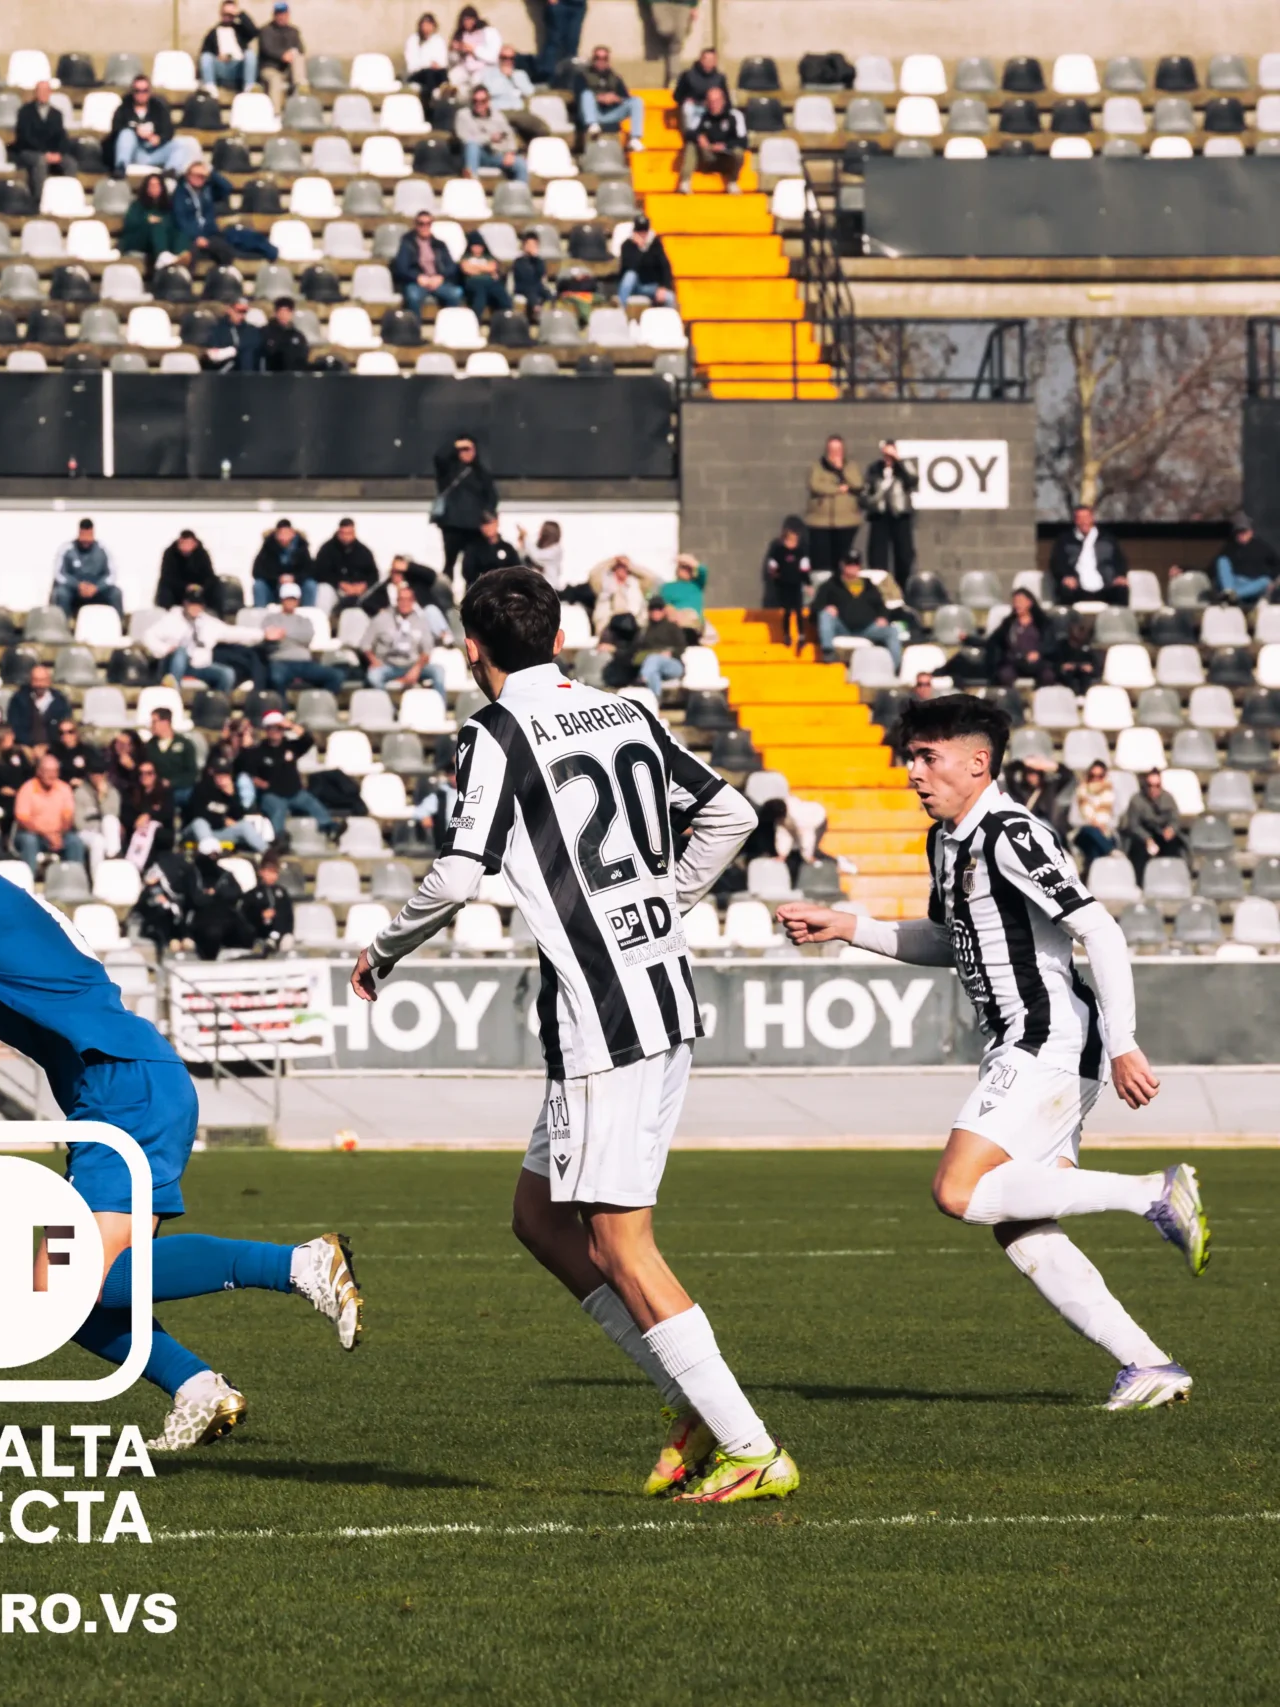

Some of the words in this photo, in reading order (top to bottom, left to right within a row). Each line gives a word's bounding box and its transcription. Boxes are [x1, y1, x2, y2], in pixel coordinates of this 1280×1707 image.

[555, 701, 643, 738] BARRENA
[545, 738, 673, 897] 20
[744, 978, 934, 1050] HOY
